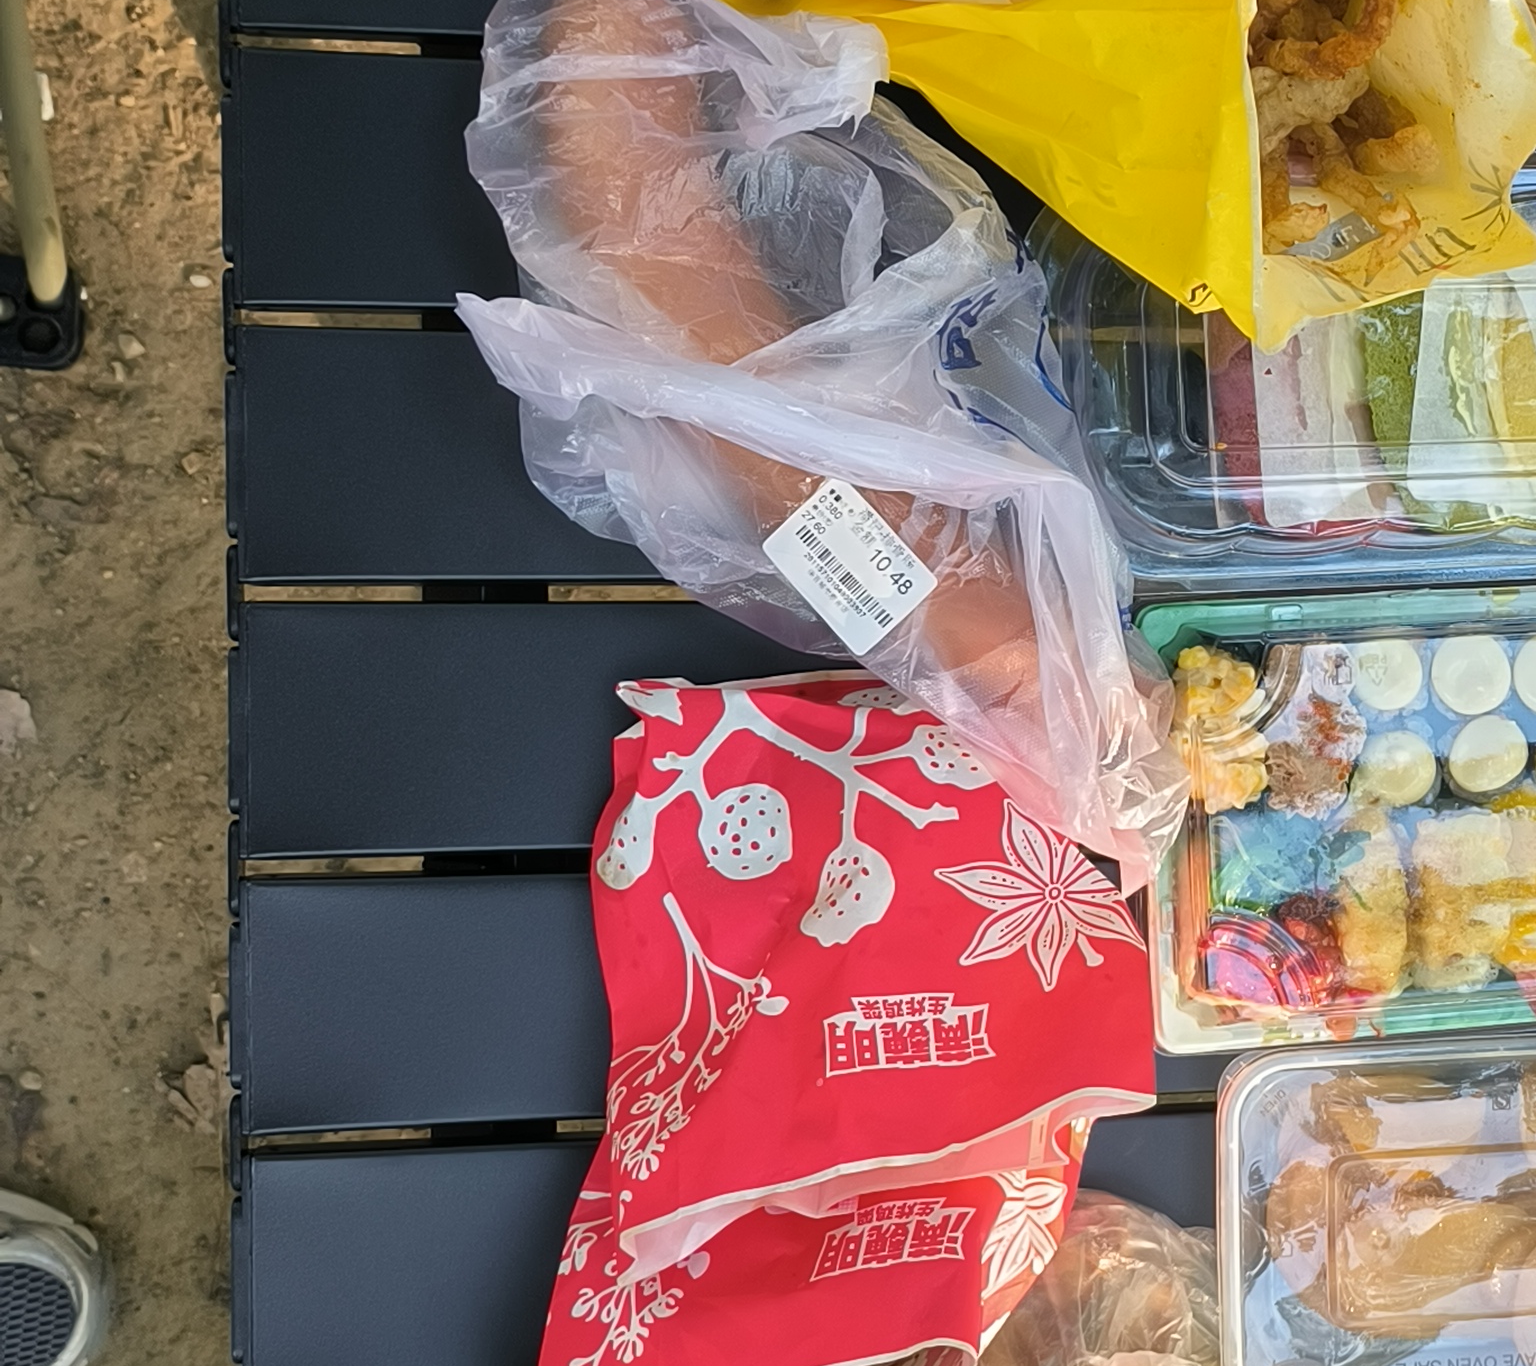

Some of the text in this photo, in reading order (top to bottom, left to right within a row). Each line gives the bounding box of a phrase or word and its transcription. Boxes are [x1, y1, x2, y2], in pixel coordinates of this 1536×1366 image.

[869, 548, 914, 596] 10.48
[858, 996, 950, 1019] 生炸鸡架
